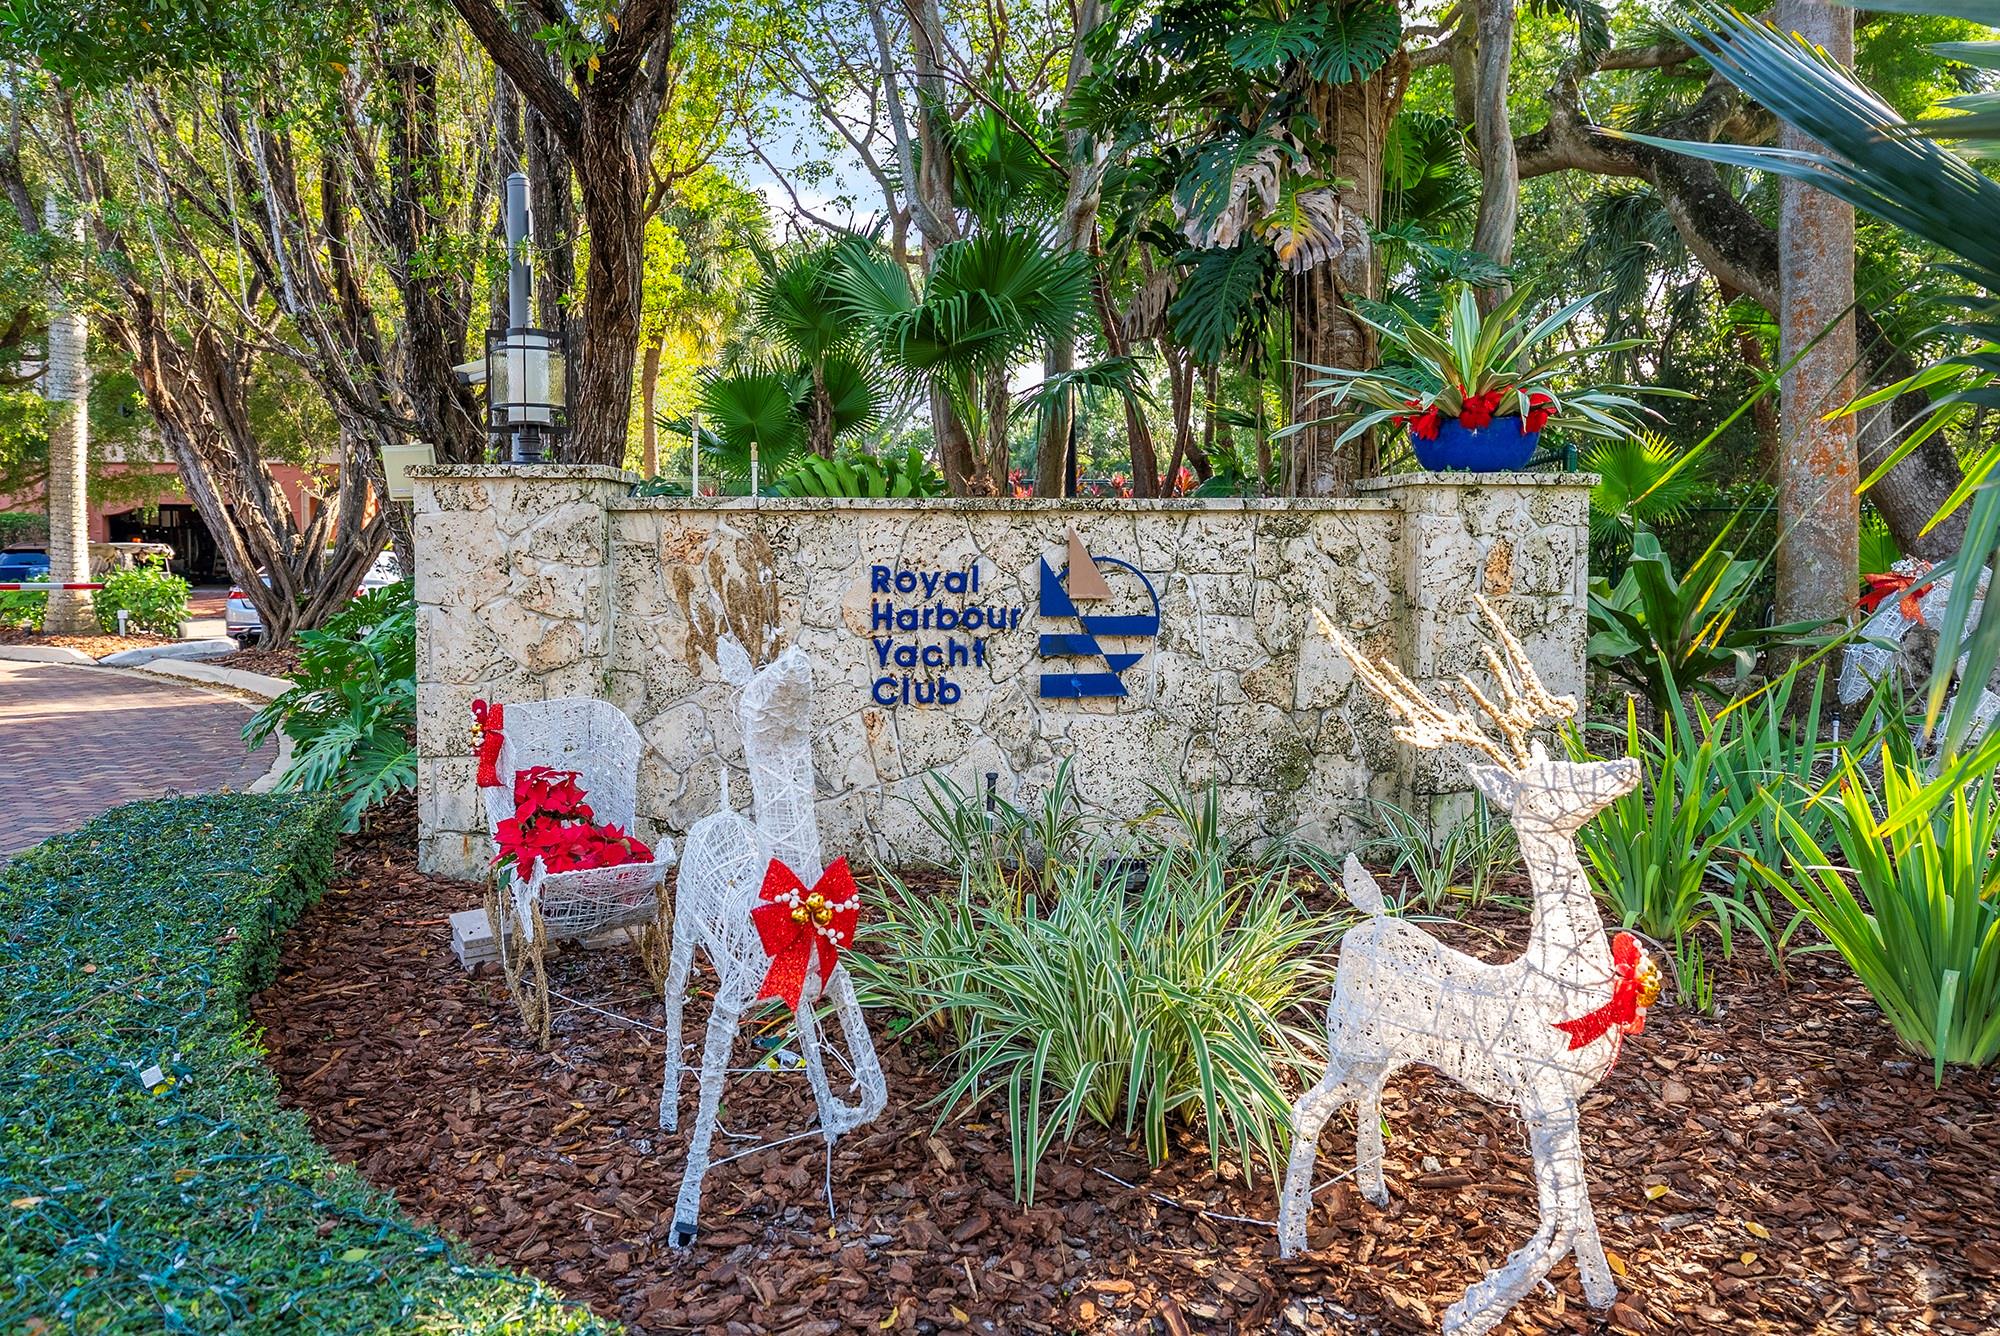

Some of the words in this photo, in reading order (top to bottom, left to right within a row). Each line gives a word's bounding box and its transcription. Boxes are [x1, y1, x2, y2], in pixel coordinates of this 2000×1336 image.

[871, 564, 980, 599] Royal
[871, 601, 1022, 631] Harbour
[871, 637, 986, 668] Yacht
[871, 676, 962, 705] Club
